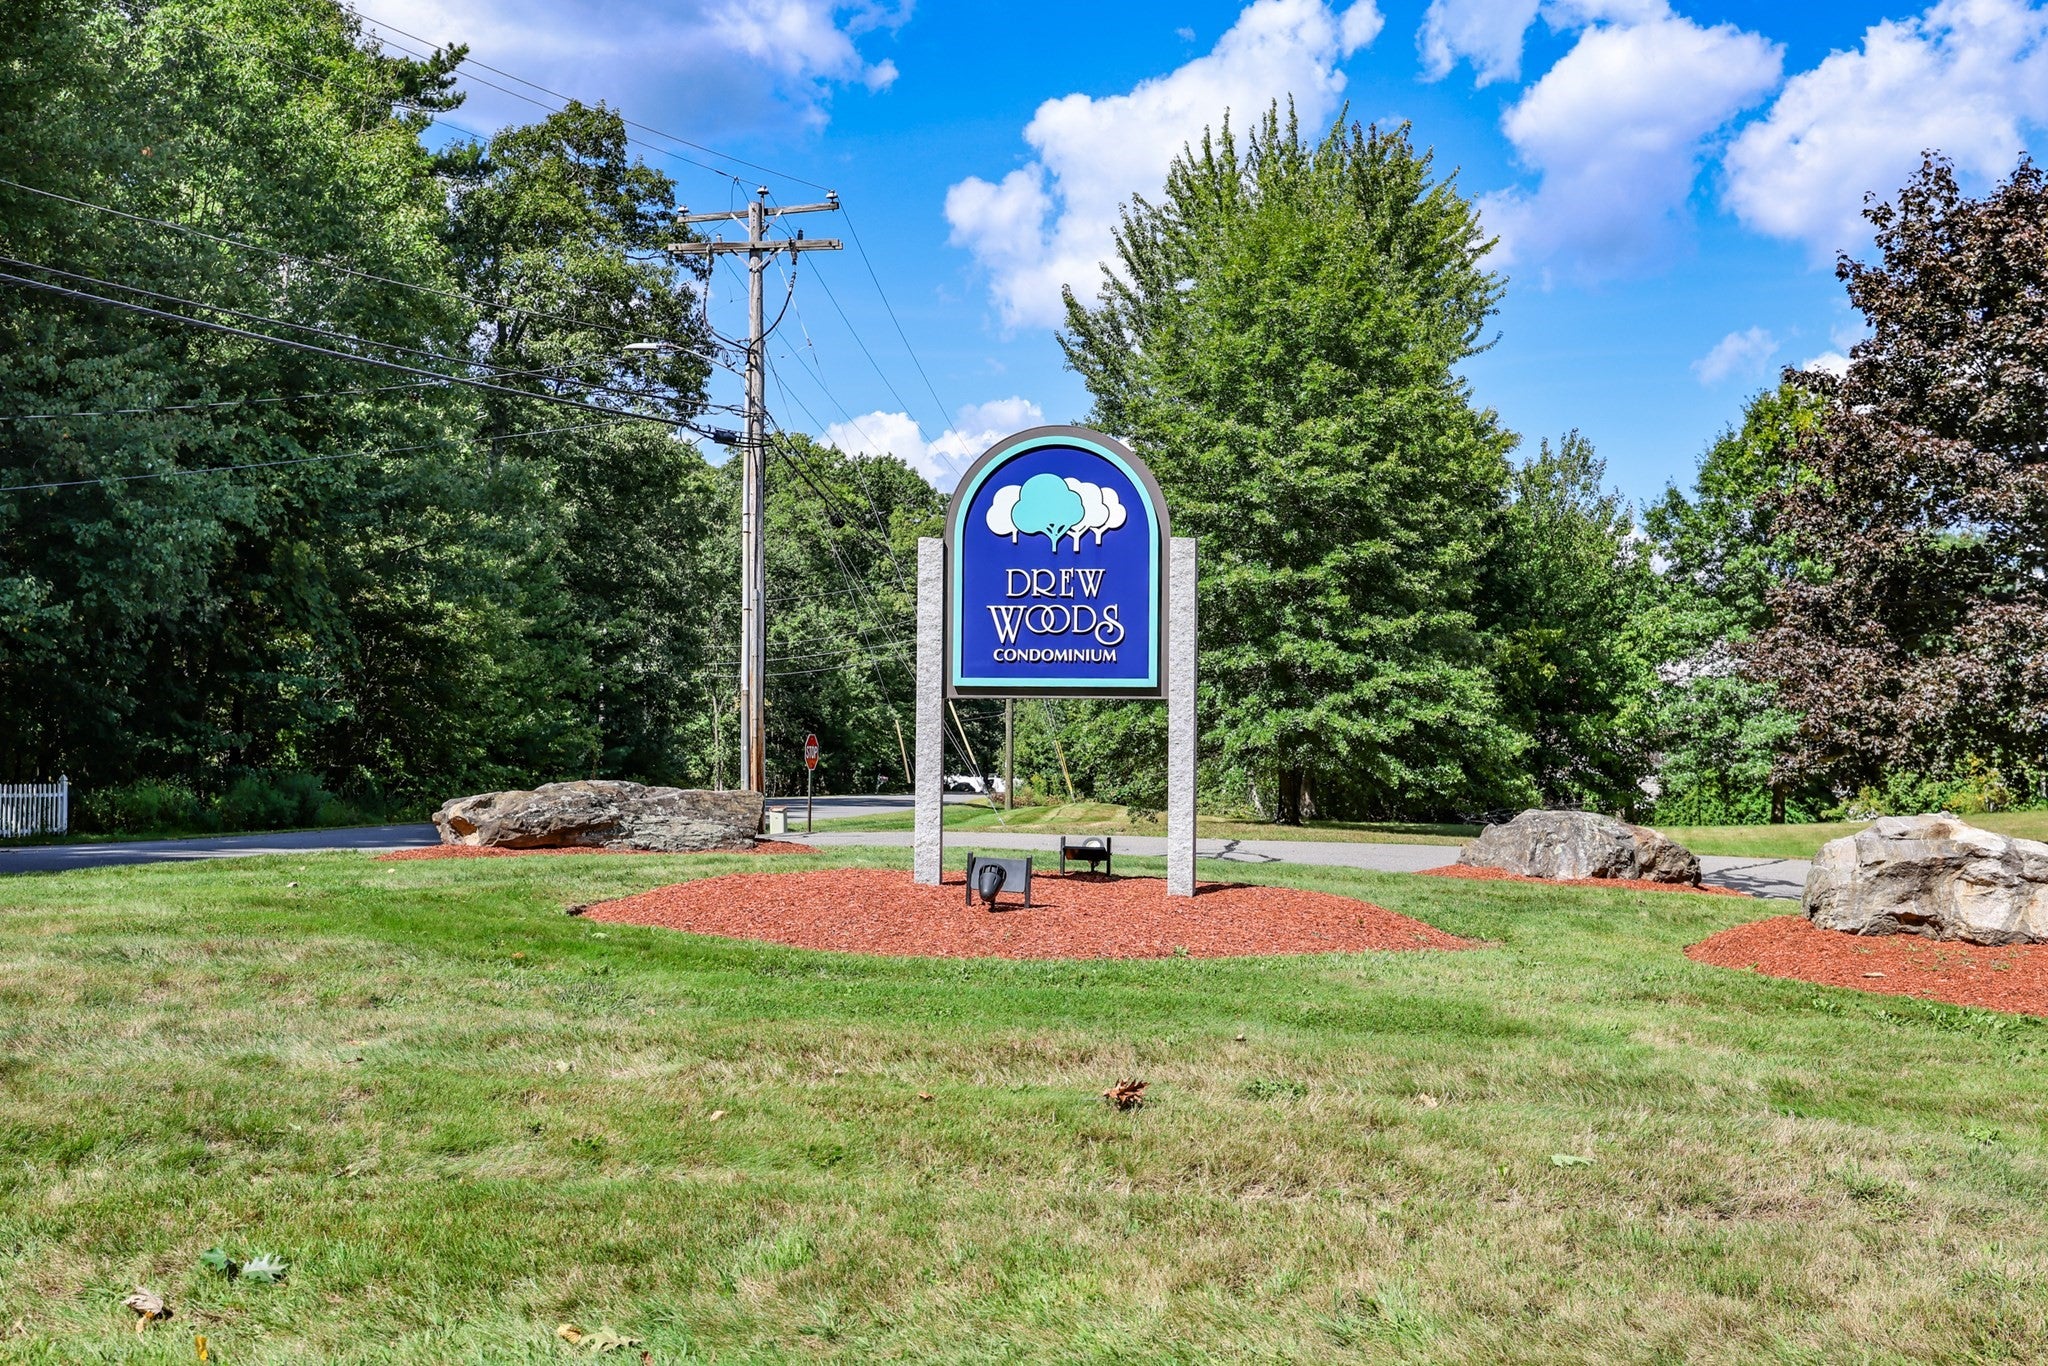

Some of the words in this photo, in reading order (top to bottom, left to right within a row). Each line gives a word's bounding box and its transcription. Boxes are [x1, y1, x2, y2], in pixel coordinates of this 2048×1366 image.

[1006, 567, 1105, 598] DREW
[986, 604, 1125, 646] WOODS
[993, 649, 1117, 662] CONDOMINIUM
[806, 746, 818, 758] STOP
